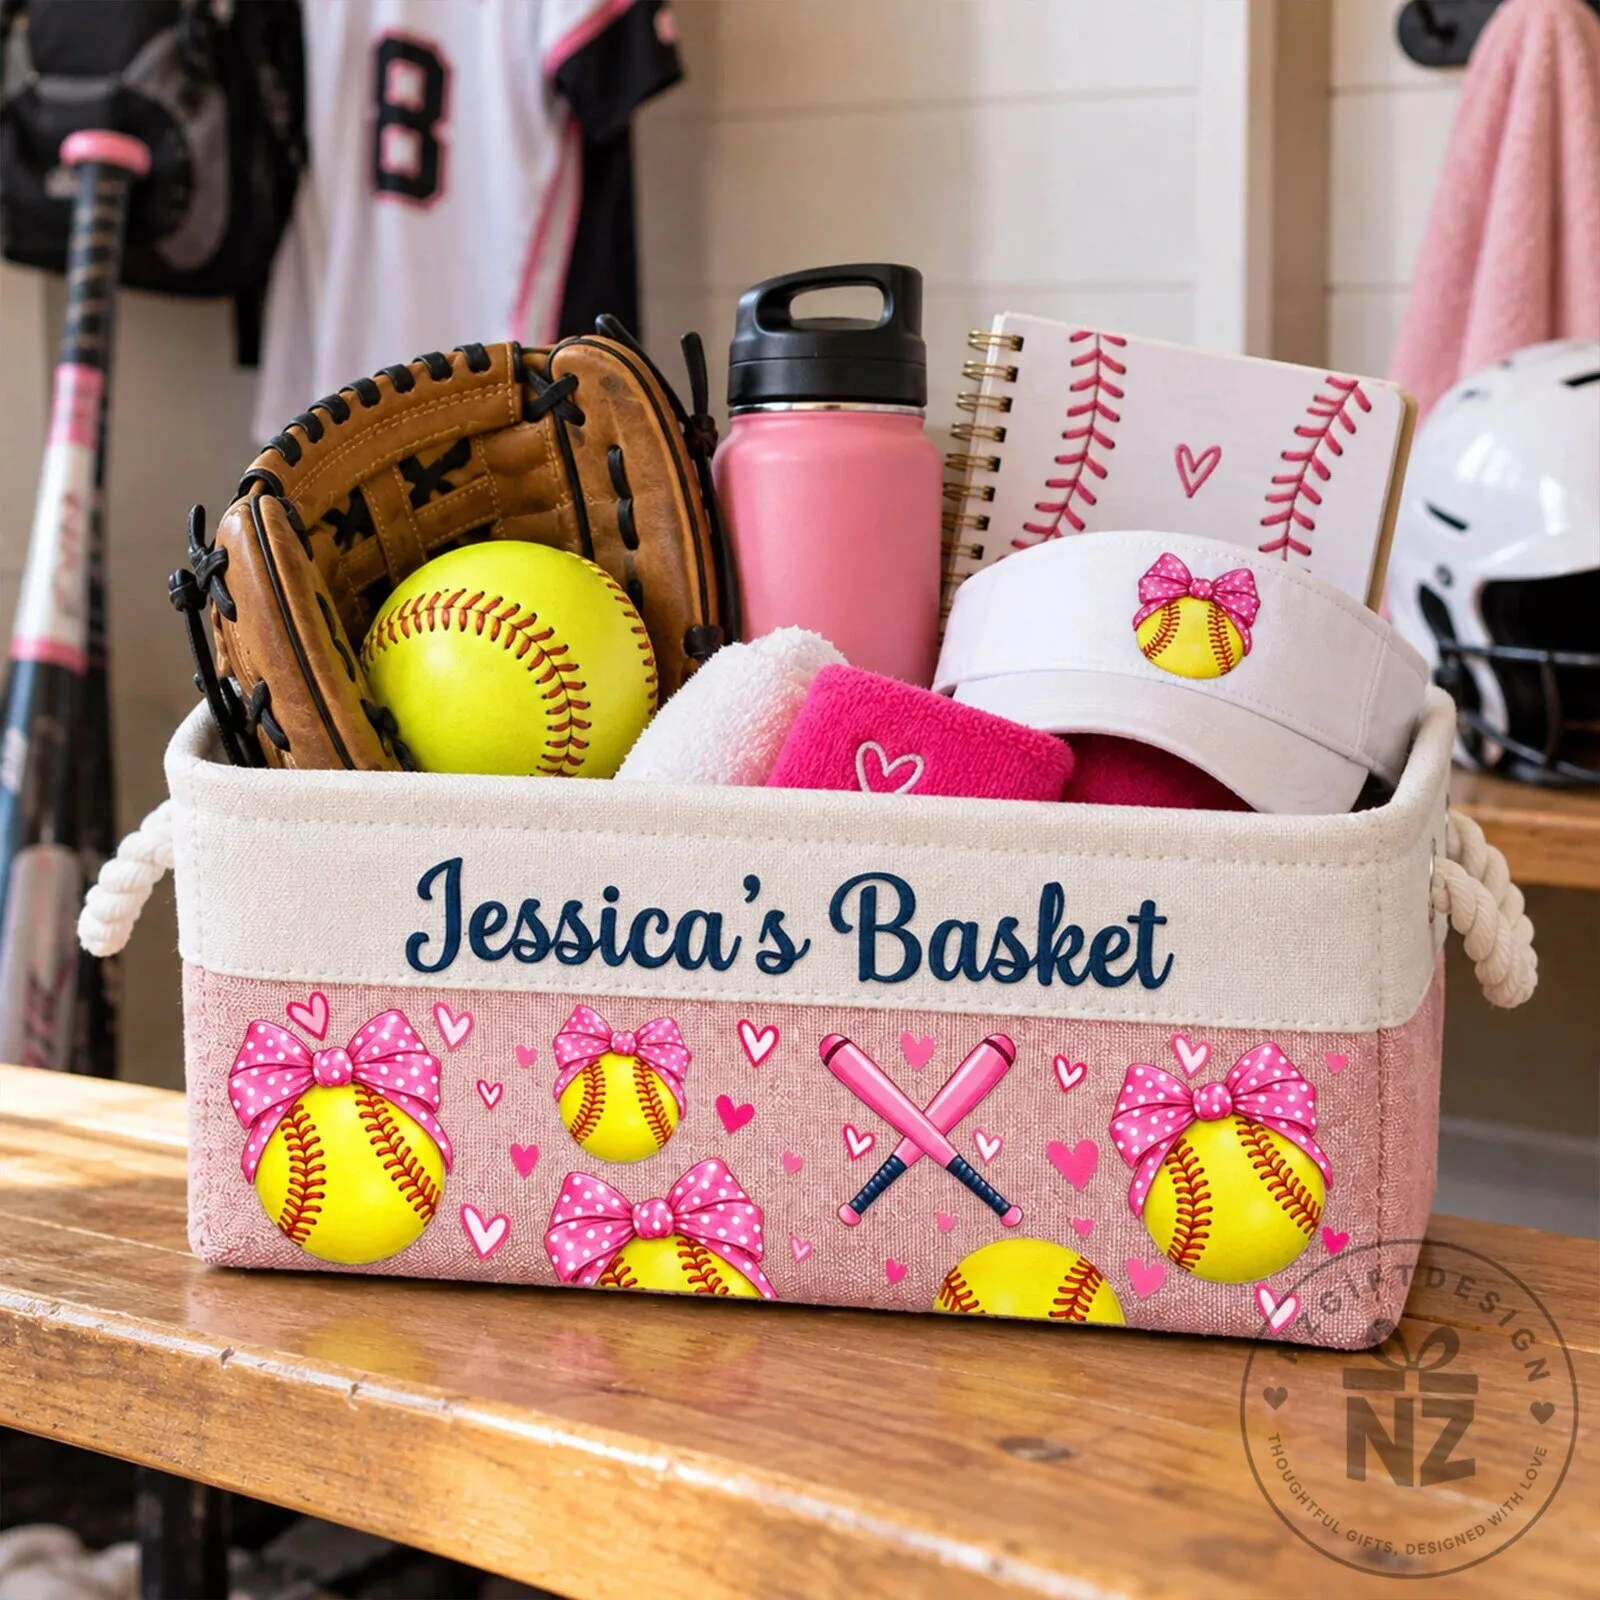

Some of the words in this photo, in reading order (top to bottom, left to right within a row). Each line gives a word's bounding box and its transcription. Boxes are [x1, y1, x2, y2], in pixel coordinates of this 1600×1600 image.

[372, 31, 450, 207] 8
[404, 856, 811, 974] Jessica's
[829, 871, 1175, 990] Basket
